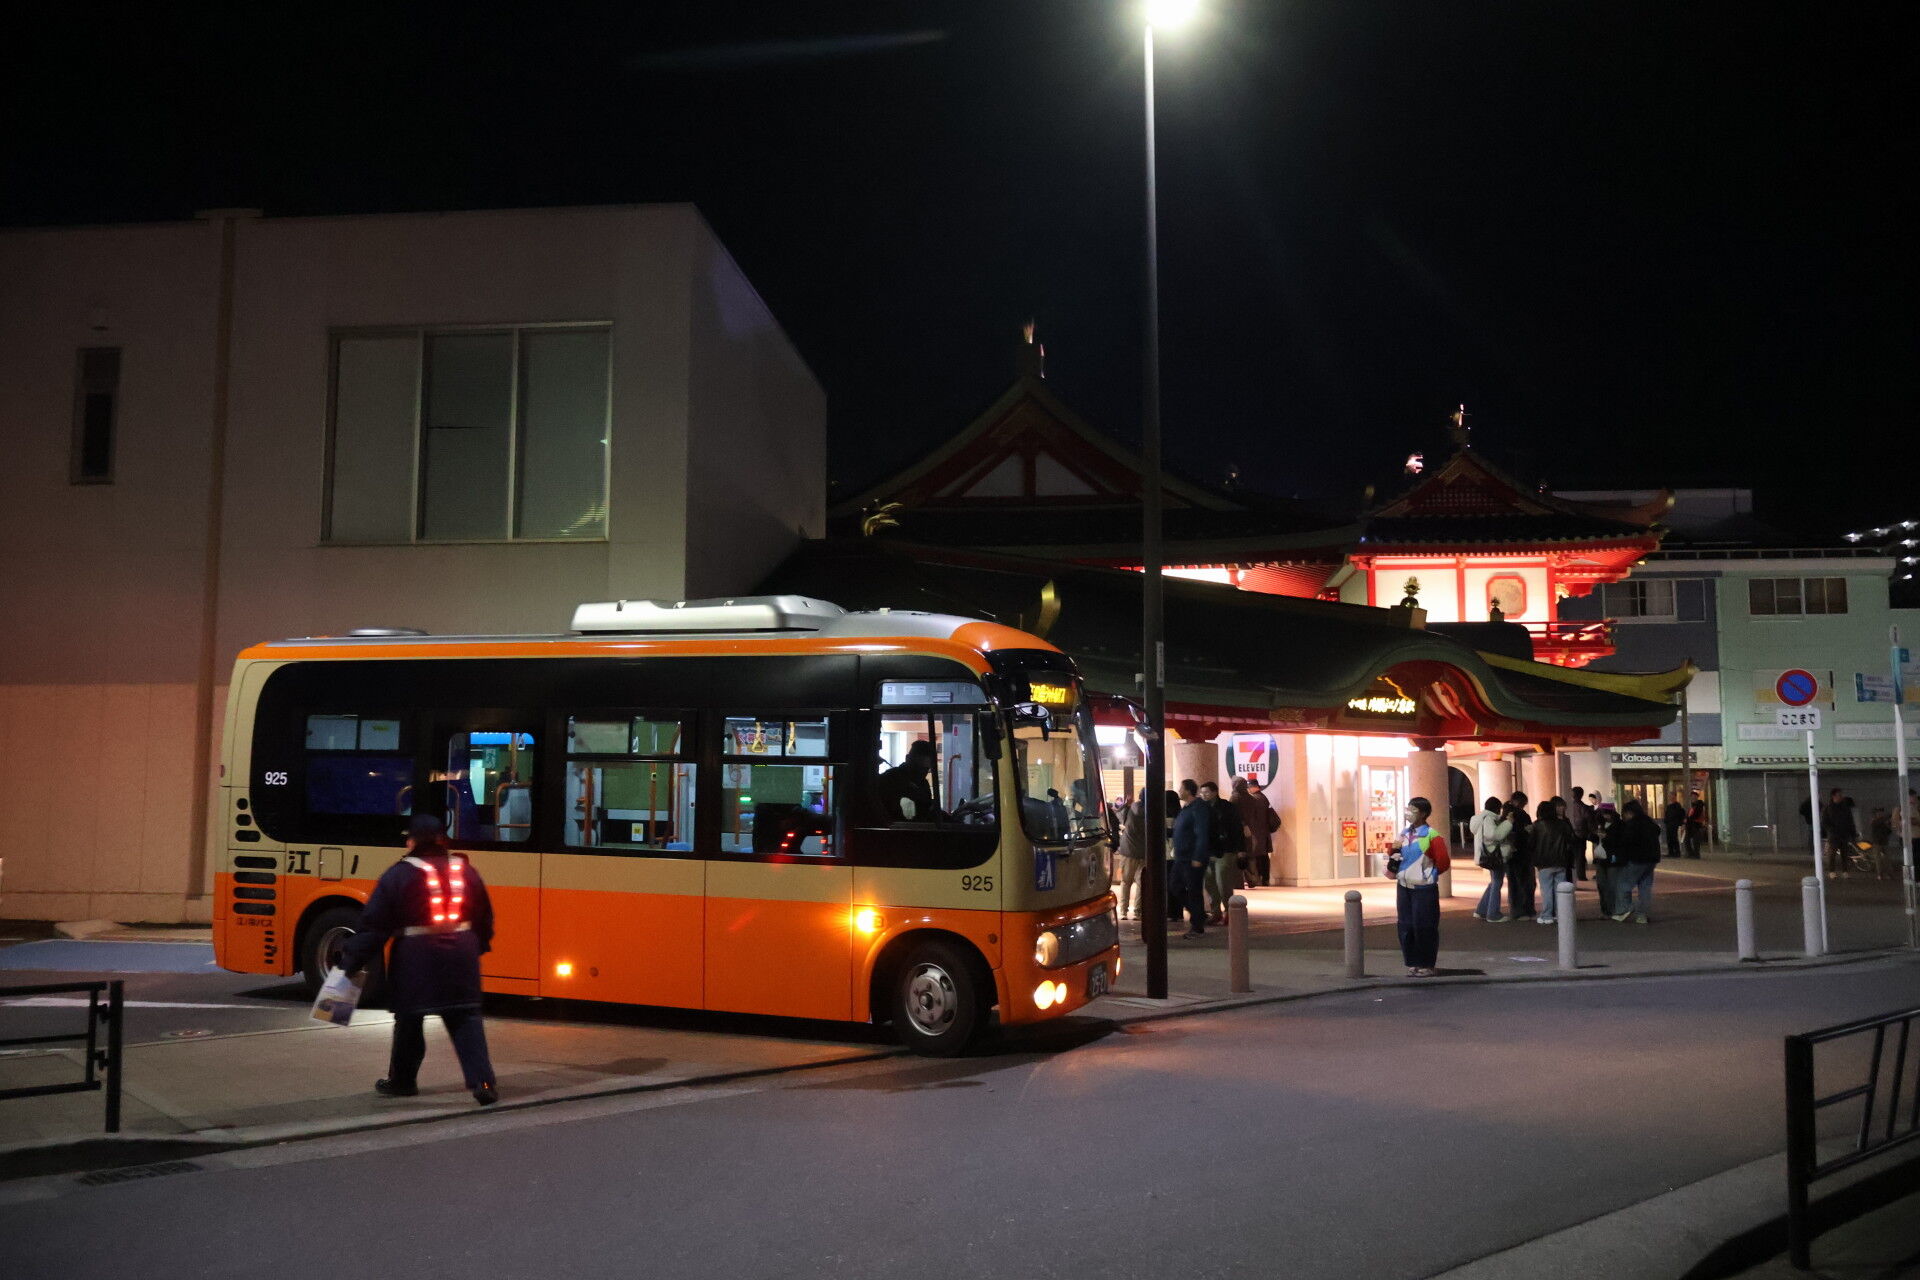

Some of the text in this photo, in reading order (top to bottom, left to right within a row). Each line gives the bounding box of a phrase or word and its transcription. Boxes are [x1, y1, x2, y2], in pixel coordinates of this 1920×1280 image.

[1781, 713, 1816, 726] ここまで
[1621, 753, 1652, 762] Katase
[265, 771, 288, 786] 925
[961, 875, 994, 892] 925
